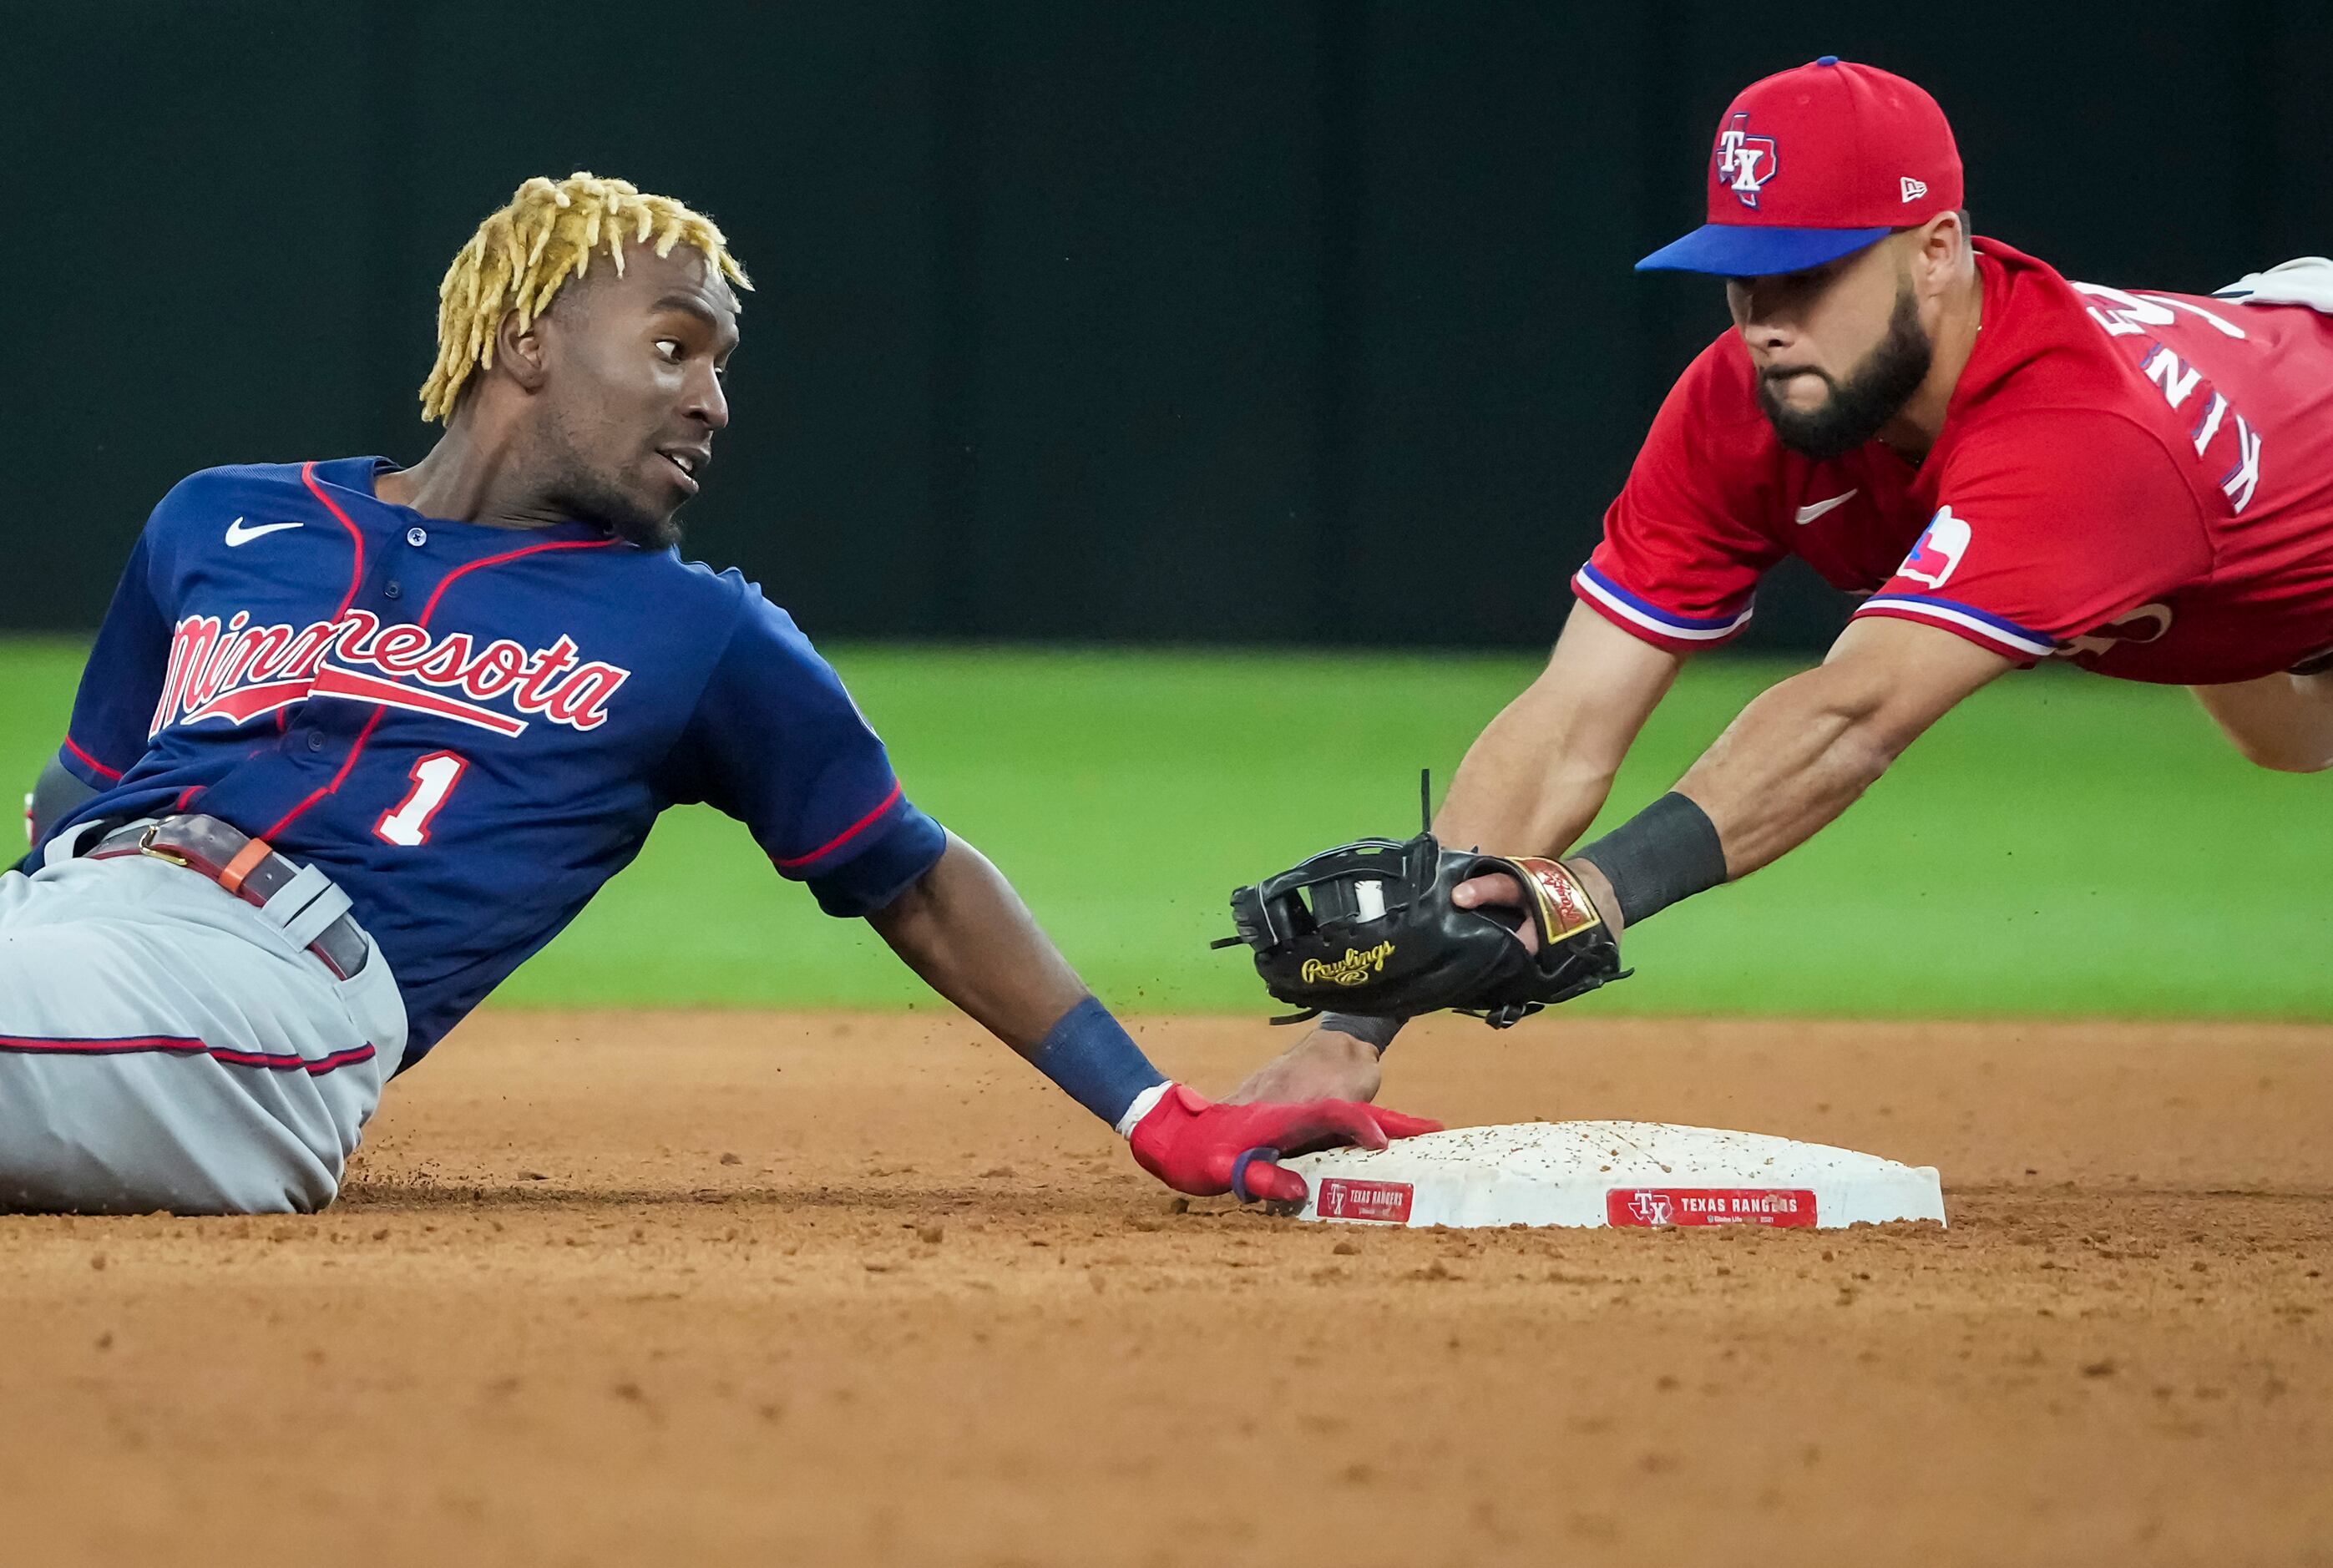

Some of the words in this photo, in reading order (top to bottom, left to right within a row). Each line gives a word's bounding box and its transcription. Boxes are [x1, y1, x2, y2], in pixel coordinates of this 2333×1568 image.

[148, 608, 631, 742] Minnesota
[372, 749, 468, 847] 1
[1302, 940, 1395, 984] Rawlings
[1349, 1189, 1370, 1204] TEXAS
[1371, 1191, 1403, 1206] RANGERS
[1681, 1197, 1726, 1212] TEXAS
